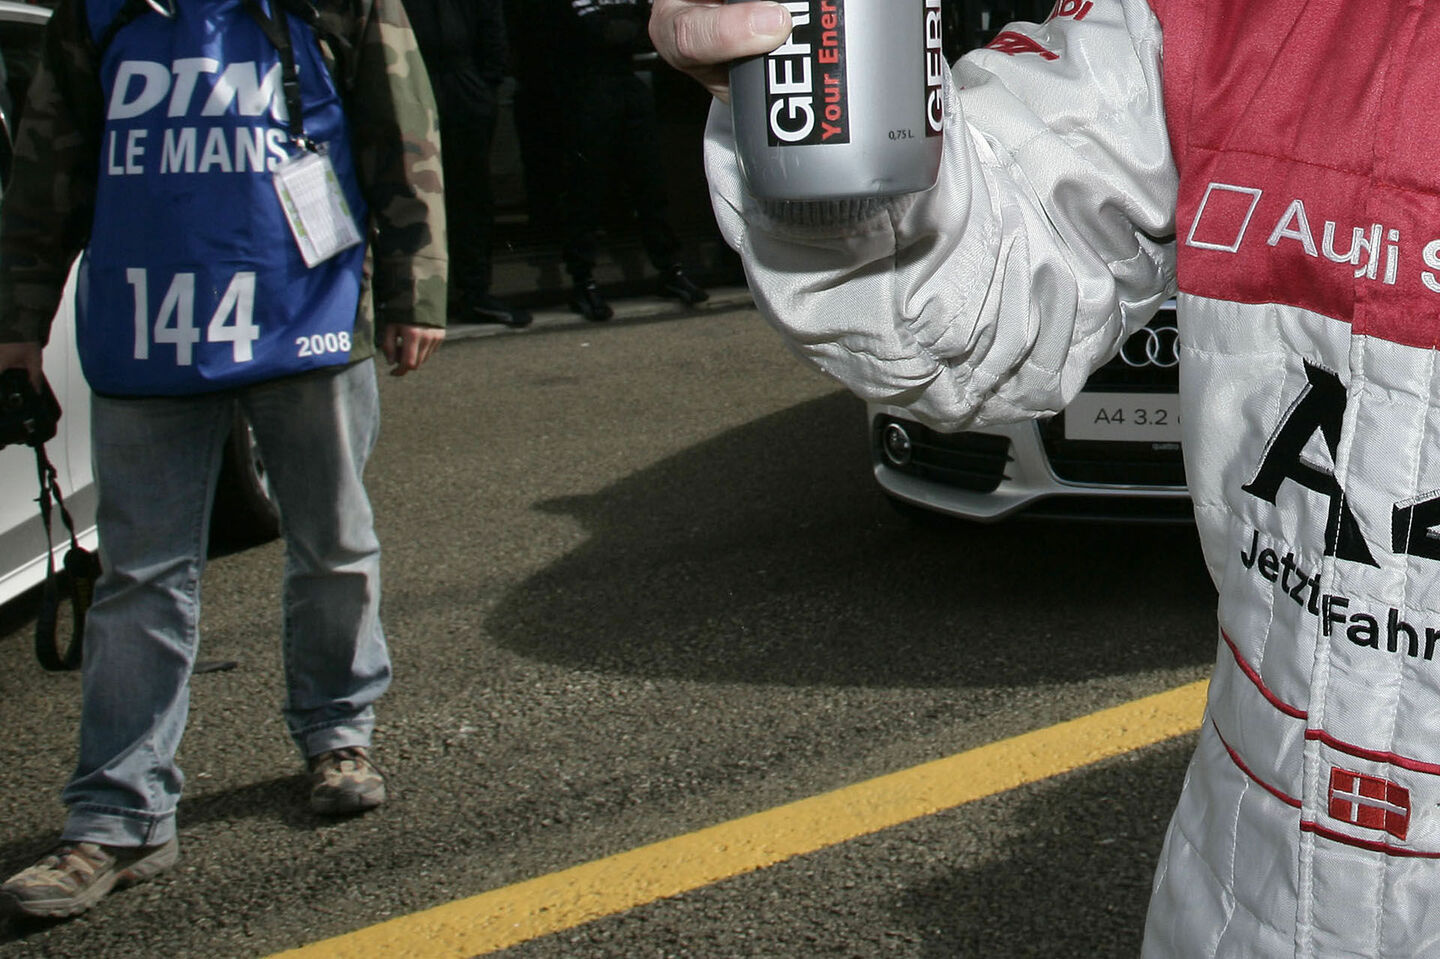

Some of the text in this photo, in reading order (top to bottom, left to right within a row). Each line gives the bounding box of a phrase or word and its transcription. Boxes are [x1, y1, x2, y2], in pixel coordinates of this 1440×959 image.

[107, 57, 298, 122] DTM
[822, 73, 842, 140] Your
[108, 127, 290, 175] LE MANS
[1267, 199, 1401, 285] Audi
[126, 267, 259, 366] 144
[296, 331, 351, 357] 2008
[1094, 407, 1126, 425] A4
[1134, 407, 1168, 426] 3.2
[1241, 530, 1322, 617] Jetzt
